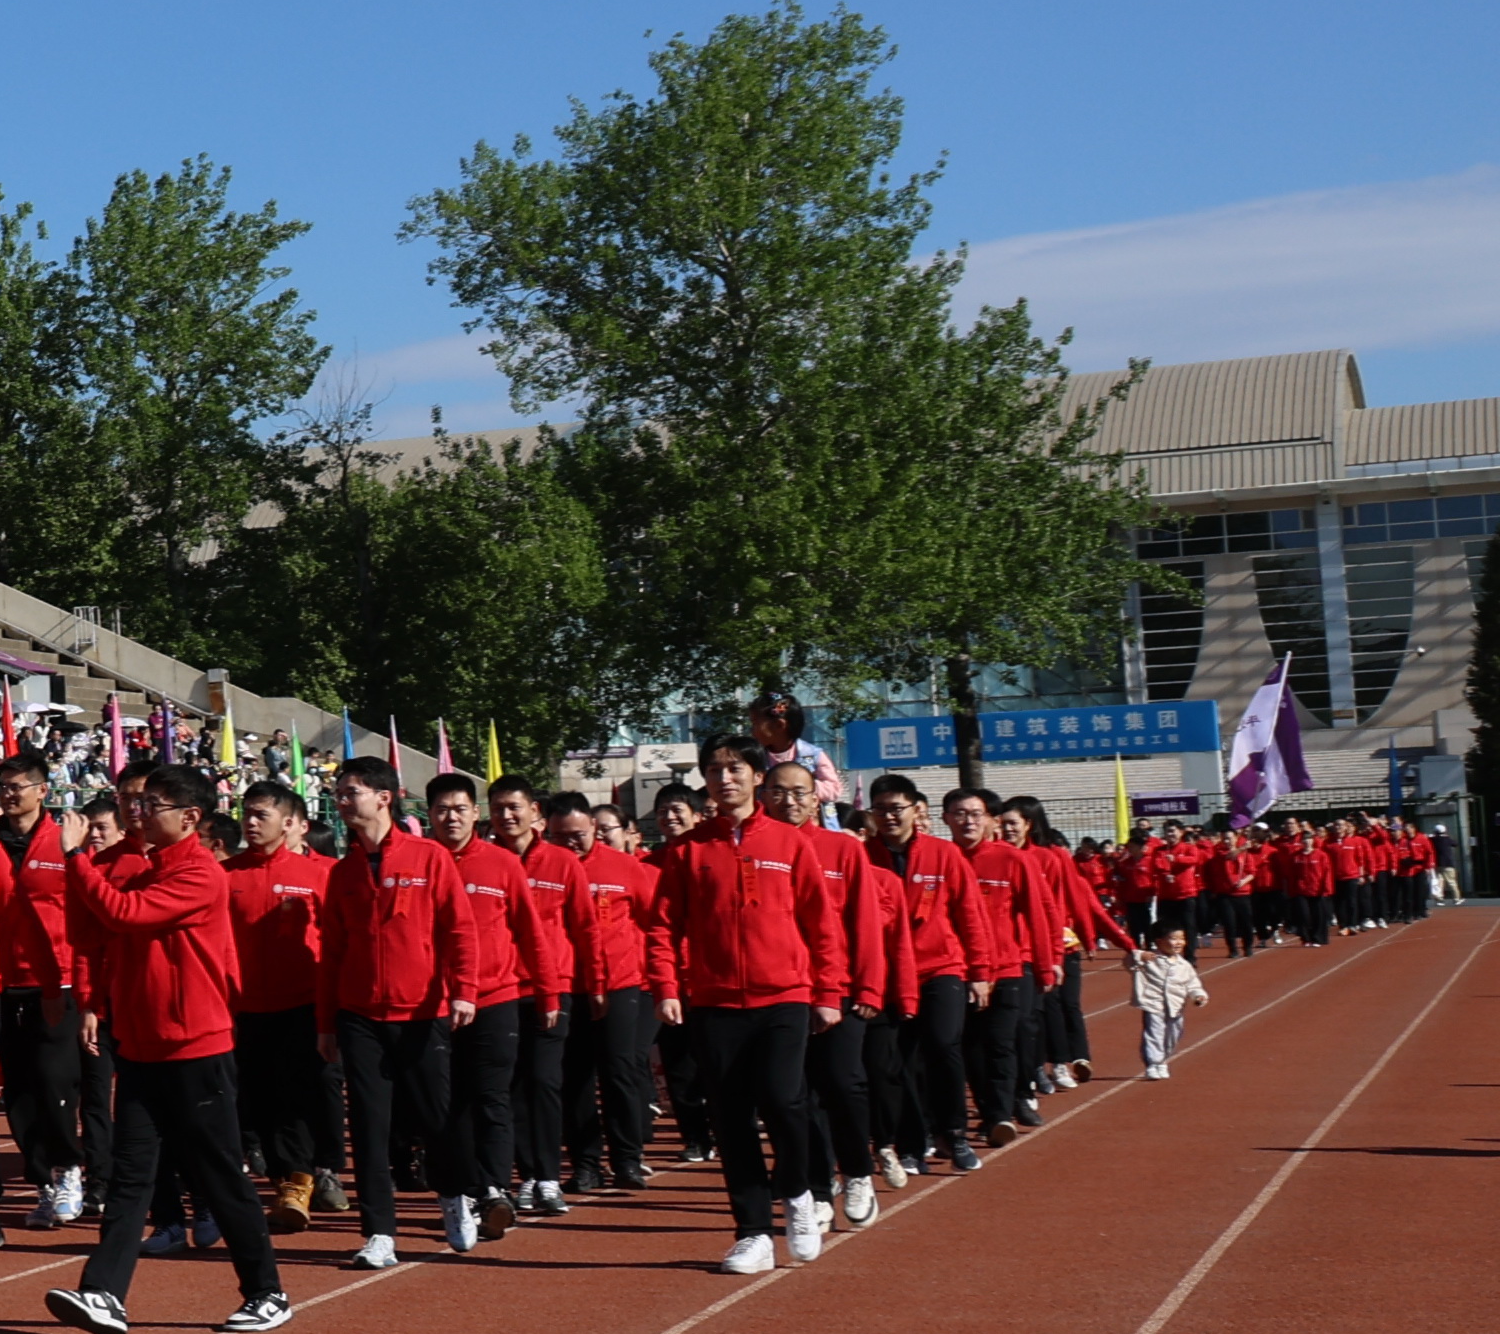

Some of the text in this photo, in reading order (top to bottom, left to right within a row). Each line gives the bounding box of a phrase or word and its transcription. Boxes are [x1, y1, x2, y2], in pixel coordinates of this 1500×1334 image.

[933, 710, 1178, 741] 中建筑装饰集团
